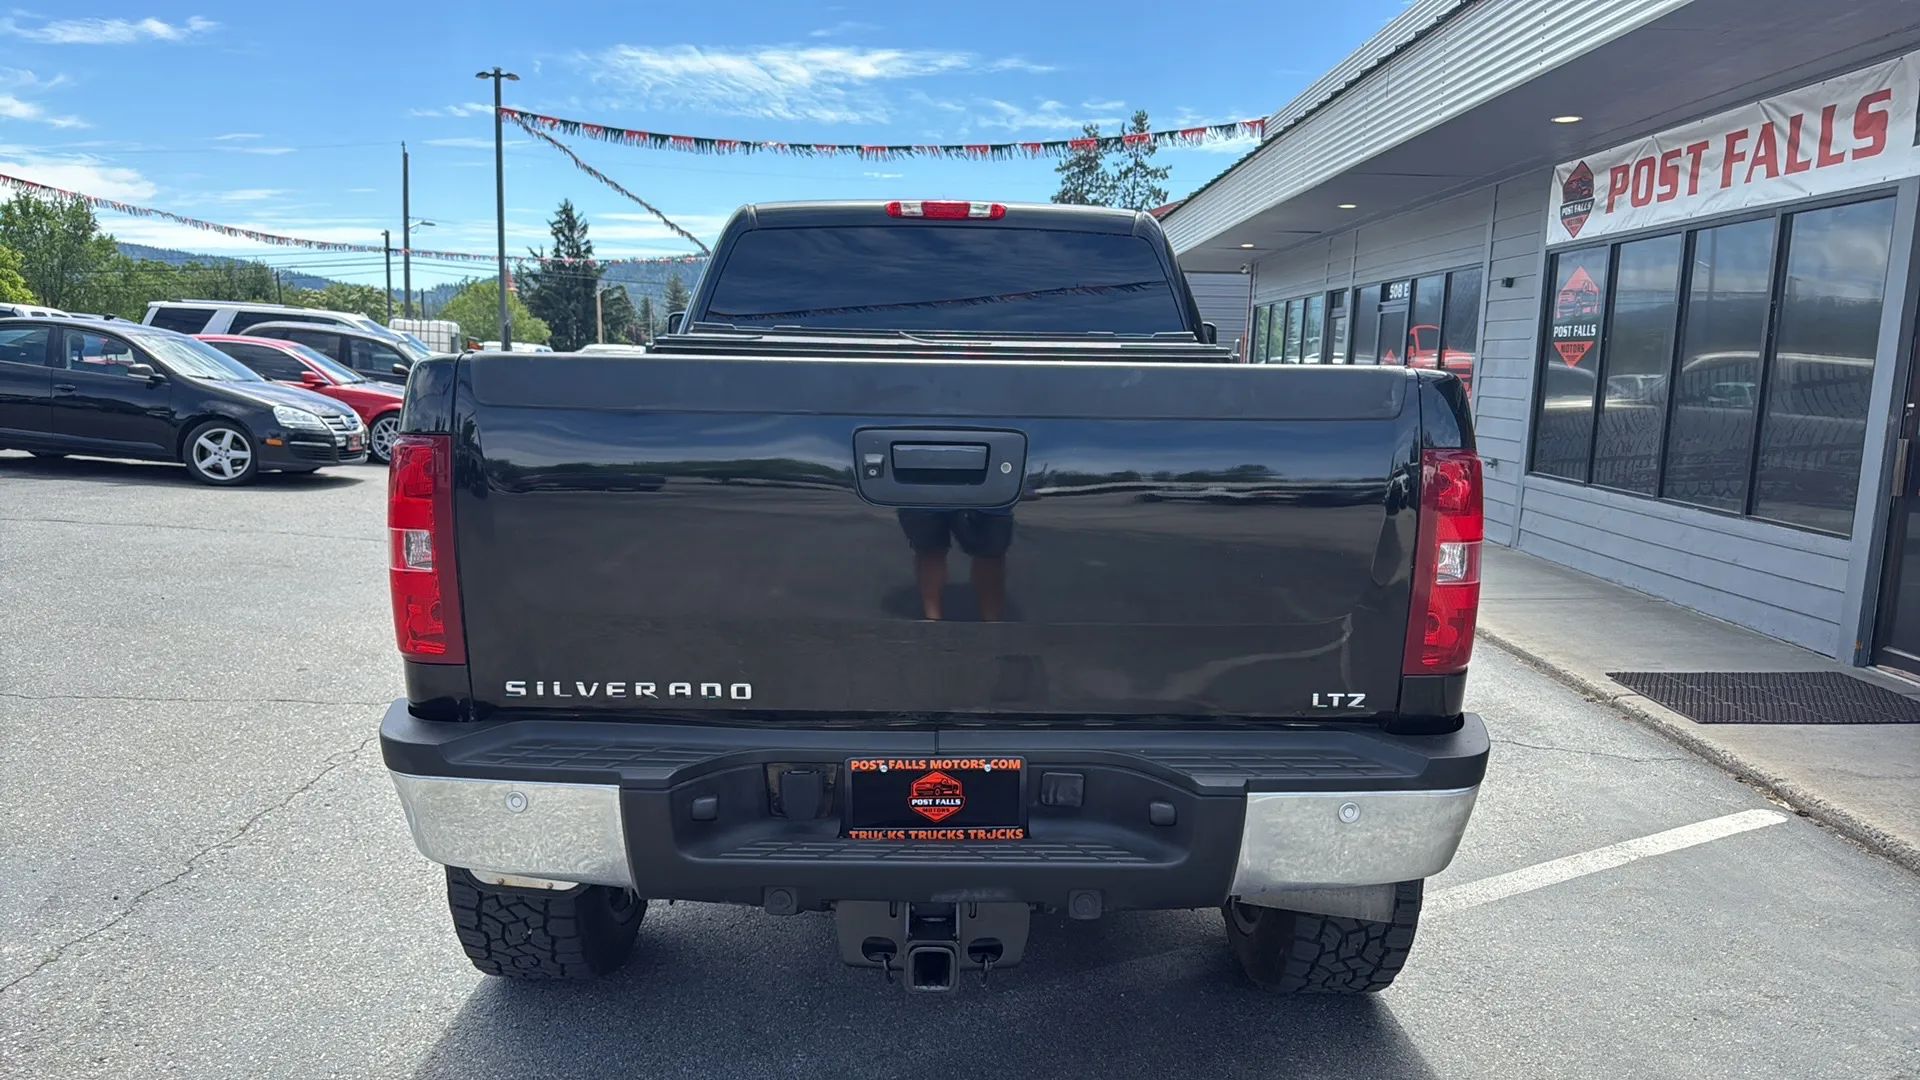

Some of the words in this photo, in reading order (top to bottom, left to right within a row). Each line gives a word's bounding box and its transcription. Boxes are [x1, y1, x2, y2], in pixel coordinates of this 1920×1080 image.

[1605, 140, 1710, 215] POST
[1720, 88, 1892, 190] FALLS
[1389, 283, 1403, 299] 508
[1553, 325, 1573, 338] POST
[1573, 324, 1597, 337] FALLS
[1560, 343, 1585, 353] MOTORS
[505, 680, 752, 700] SILVERADO
[1311, 692, 1366, 708] LTZ
[850, 759, 885, 771] POST
[888, 759, 926, 770] FALLS
[929, 759, 1021, 770] MOTORSCOM
[911, 798, 934, 806] POST
[935, 798, 961, 806] FALLS
[908, 829, 965, 840] TRUCKS
[967, 828, 1024, 840] TRUCKS
